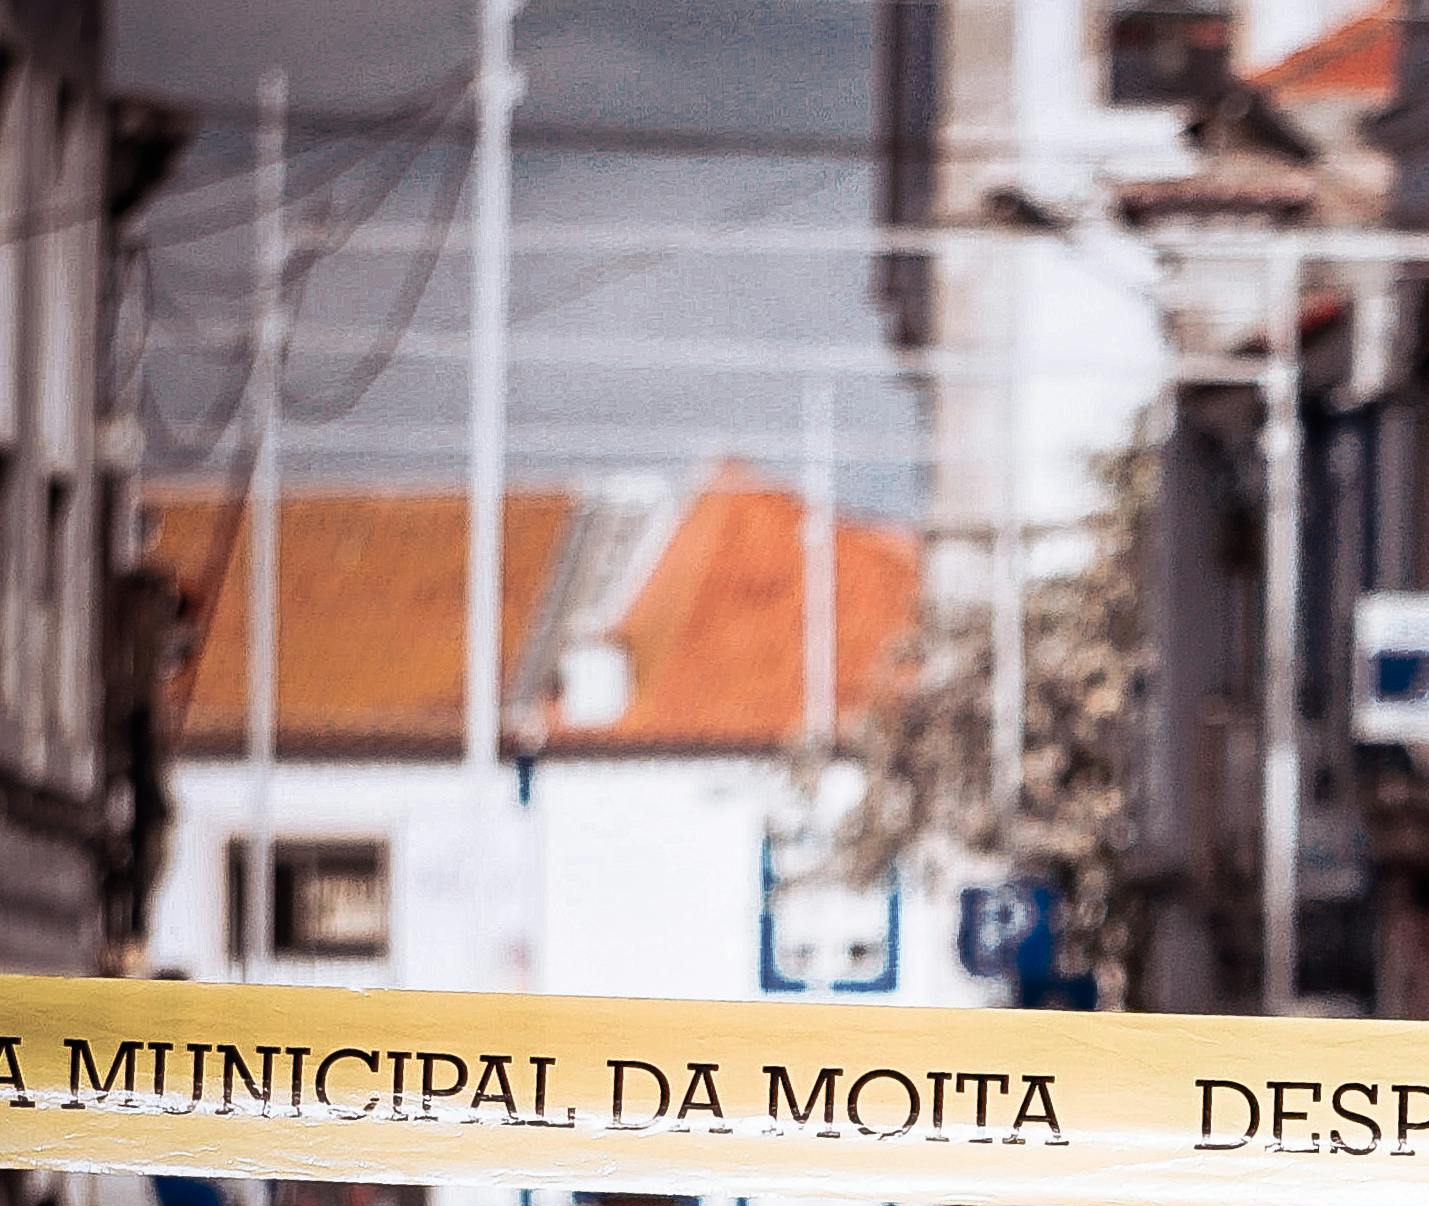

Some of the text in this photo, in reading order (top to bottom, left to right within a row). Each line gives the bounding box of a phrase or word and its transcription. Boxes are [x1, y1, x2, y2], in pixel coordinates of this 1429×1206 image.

[61, 1038, 576, 1129] MUNICIPAL
[606, 1059, 733, 1134] DA
[763, 1066, 1070, 1146] MOITA
